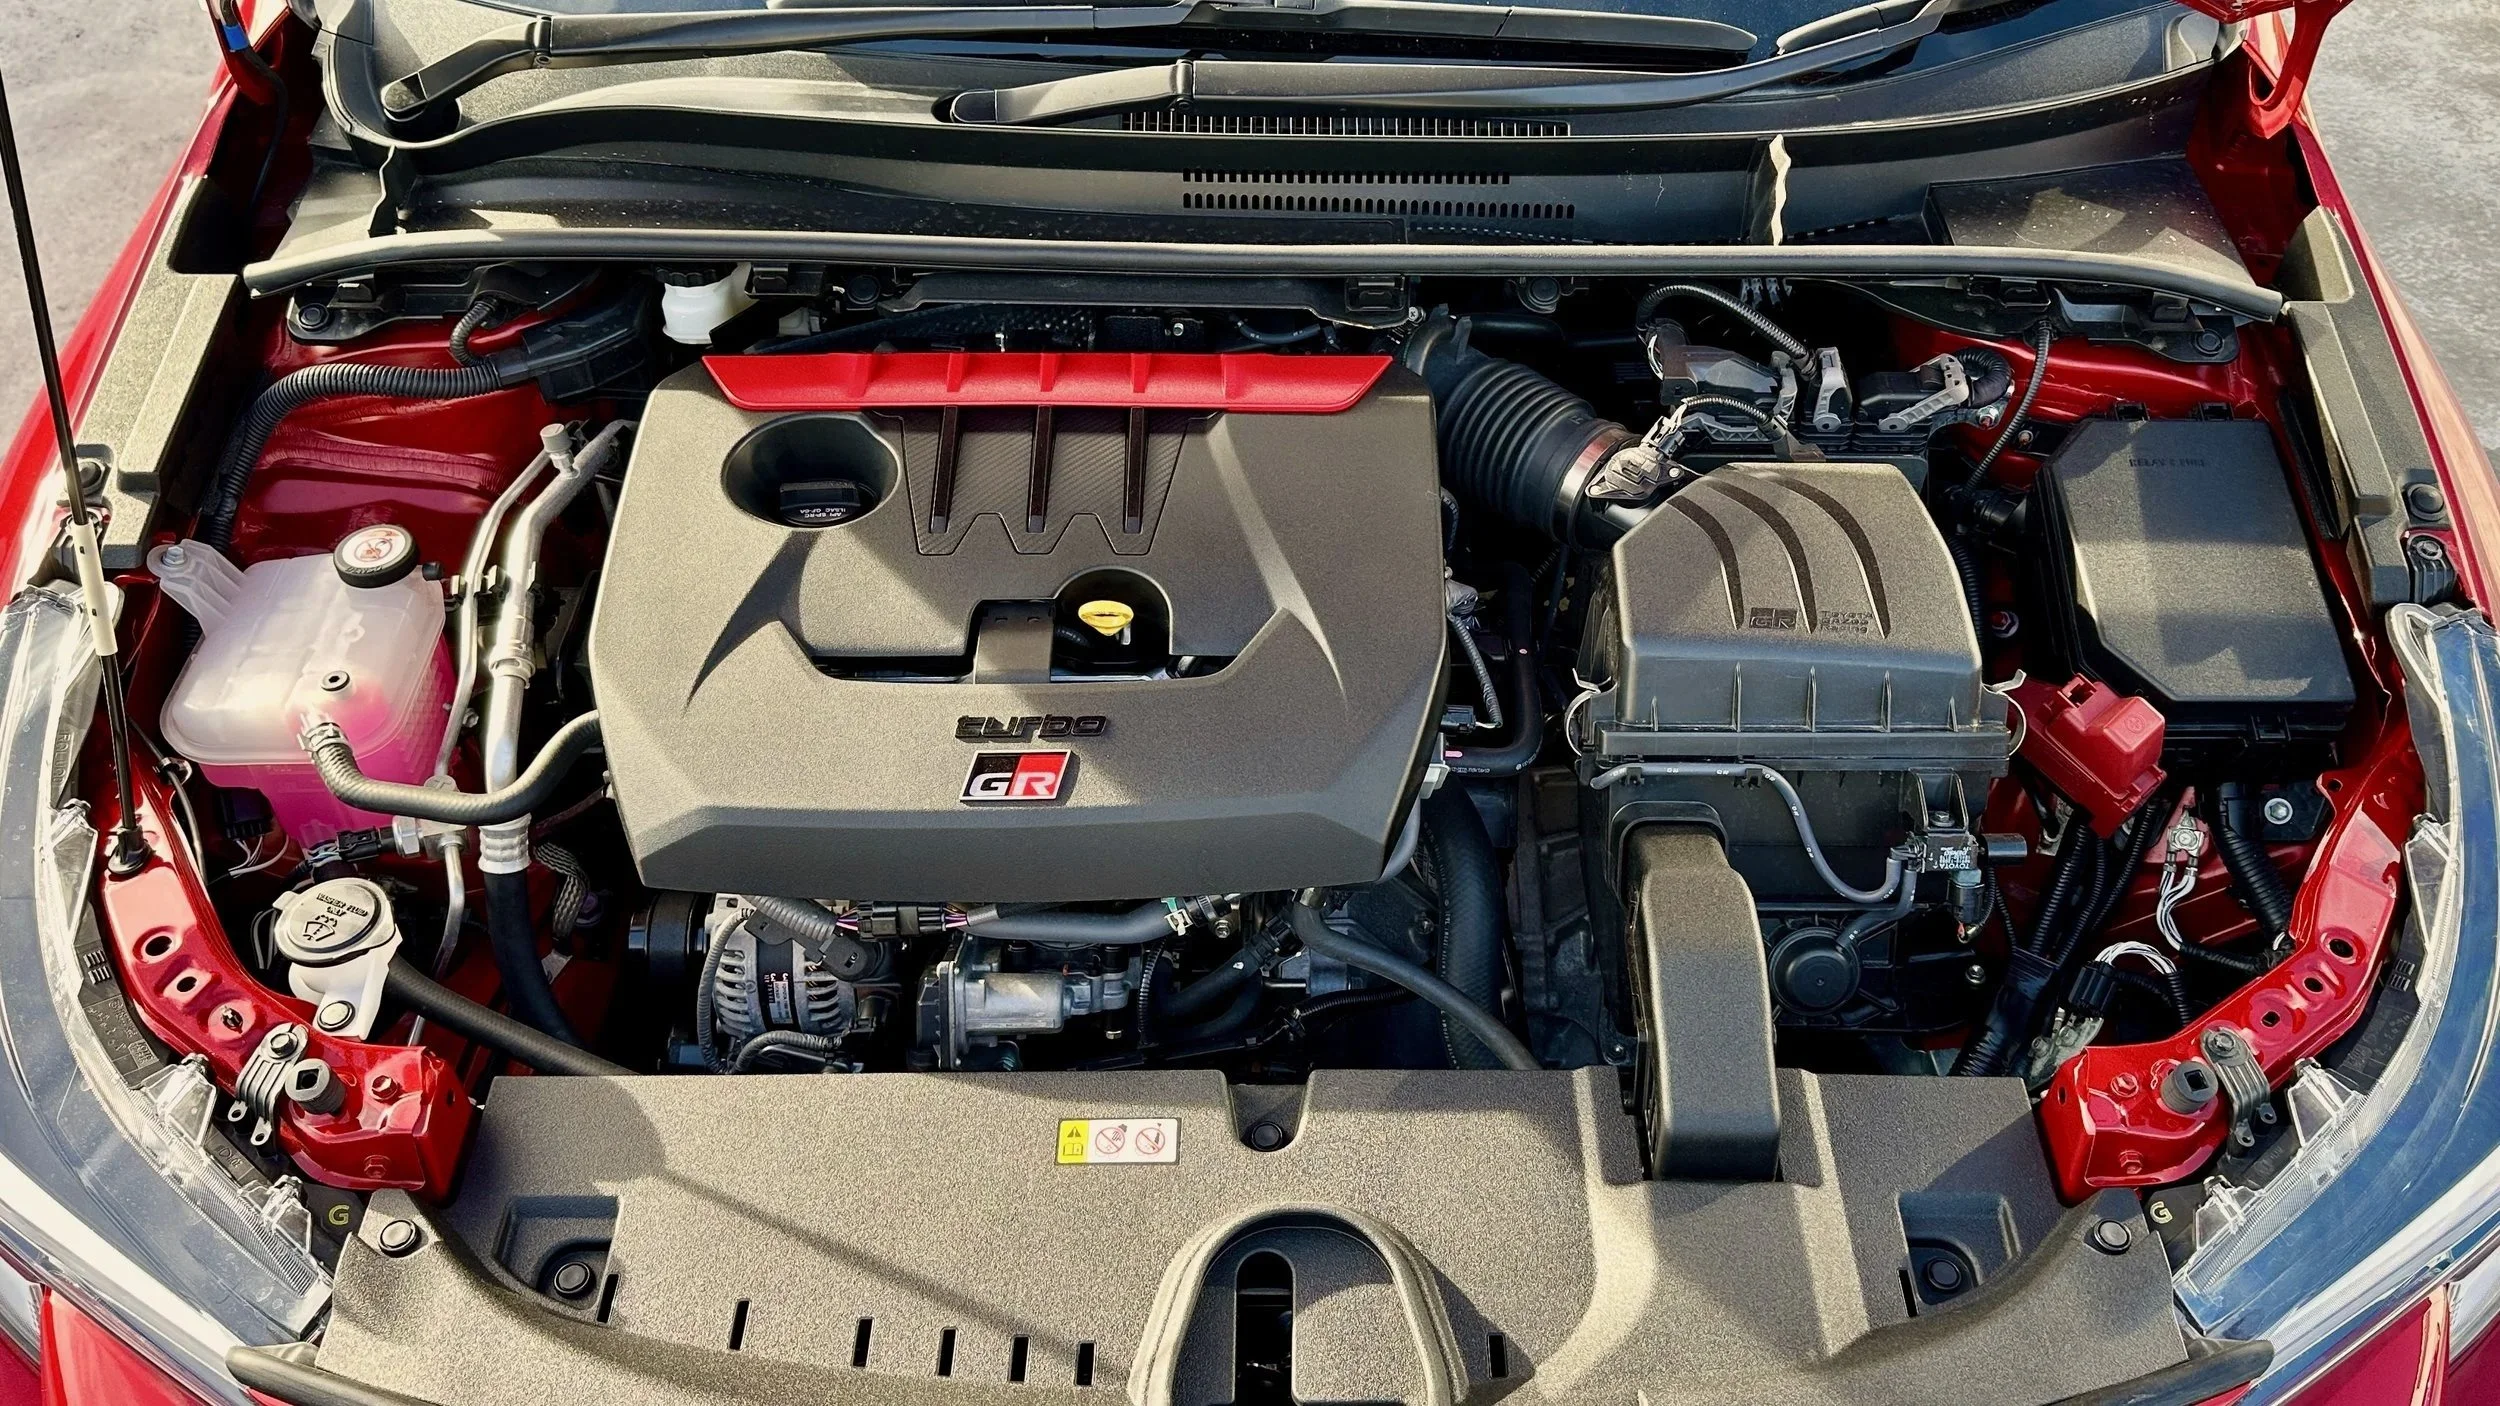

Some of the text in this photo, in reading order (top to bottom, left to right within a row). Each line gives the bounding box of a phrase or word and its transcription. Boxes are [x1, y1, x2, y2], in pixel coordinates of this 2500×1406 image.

[954, 713, 1109, 739] turbo
[968, 771, 1057, 797] GR
[328, 1204, 350, 1226] G
[2149, 1200, 2173, 1224] G
